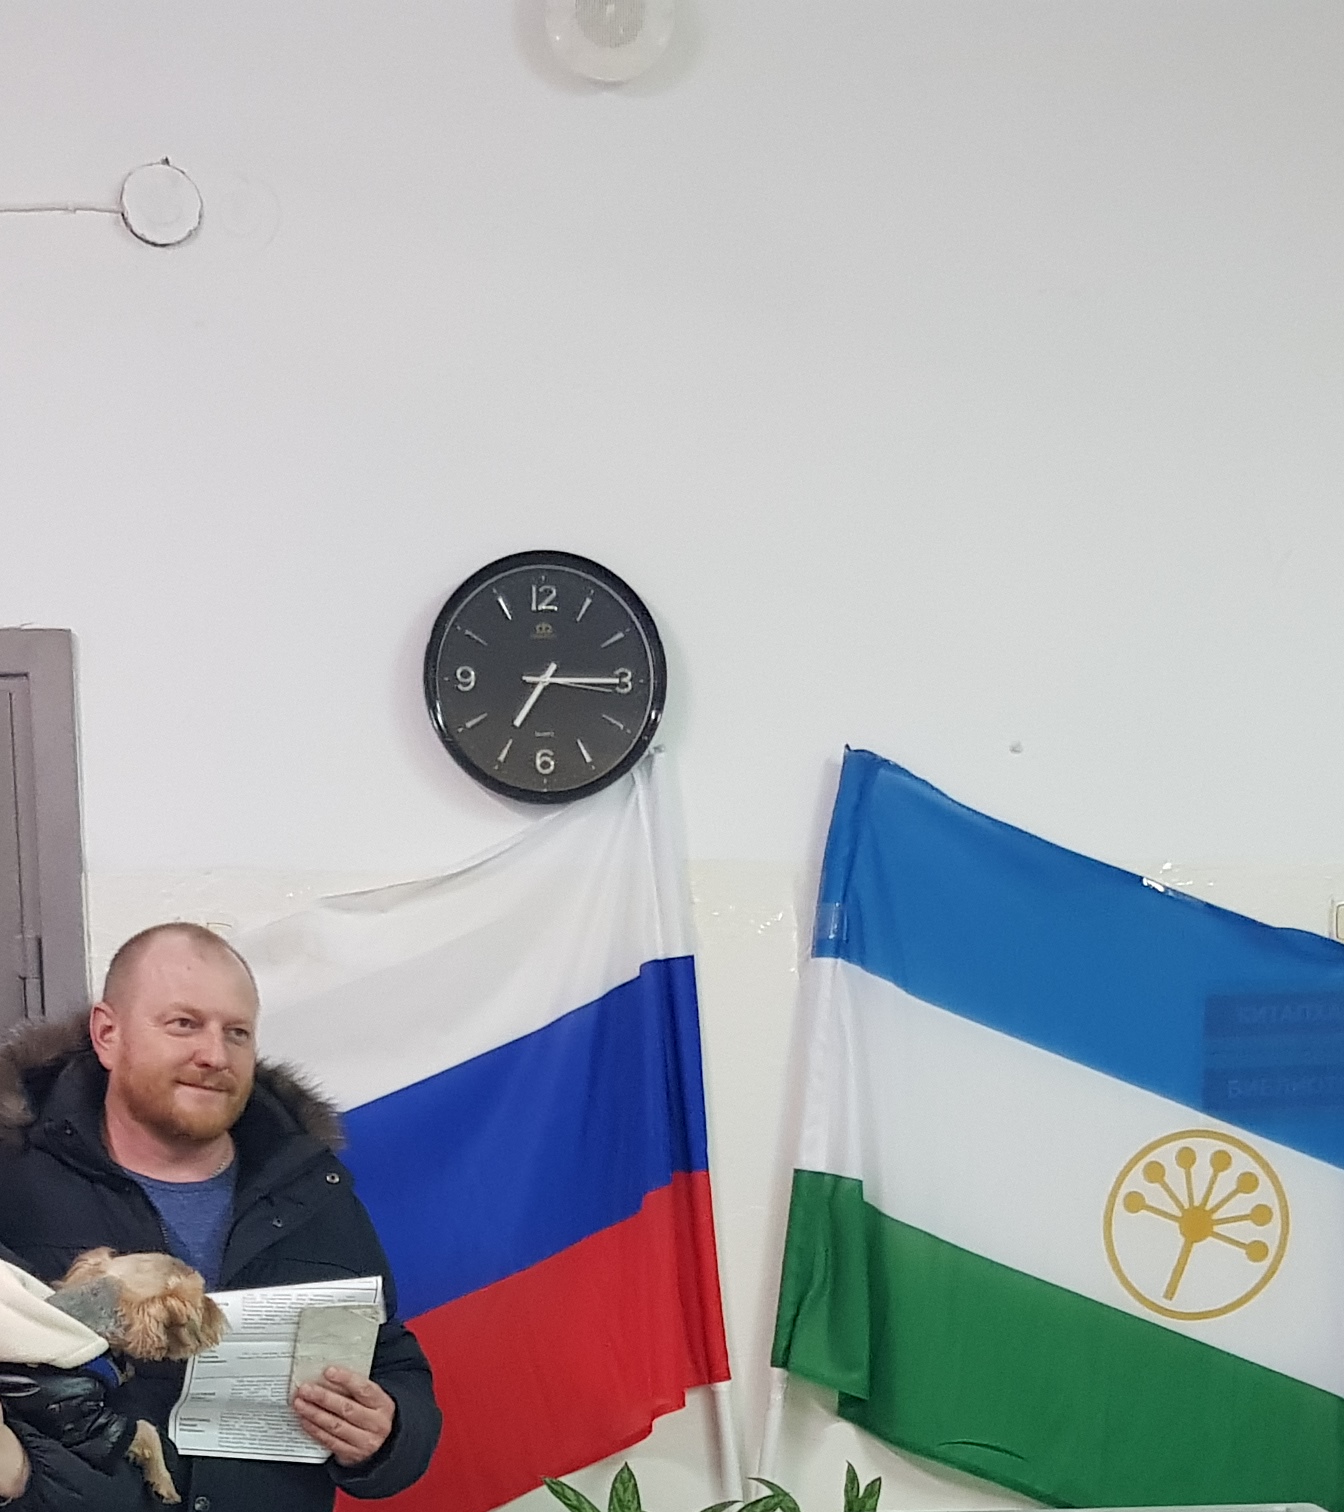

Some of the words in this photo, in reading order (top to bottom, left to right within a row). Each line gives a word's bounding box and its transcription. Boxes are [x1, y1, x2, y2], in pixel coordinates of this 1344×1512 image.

[530, 584, 558, 611] 12
[455, 666, 475, 692] 9
[613, 667, 633, 694] 3
[535, 749, 555, 775] 6
